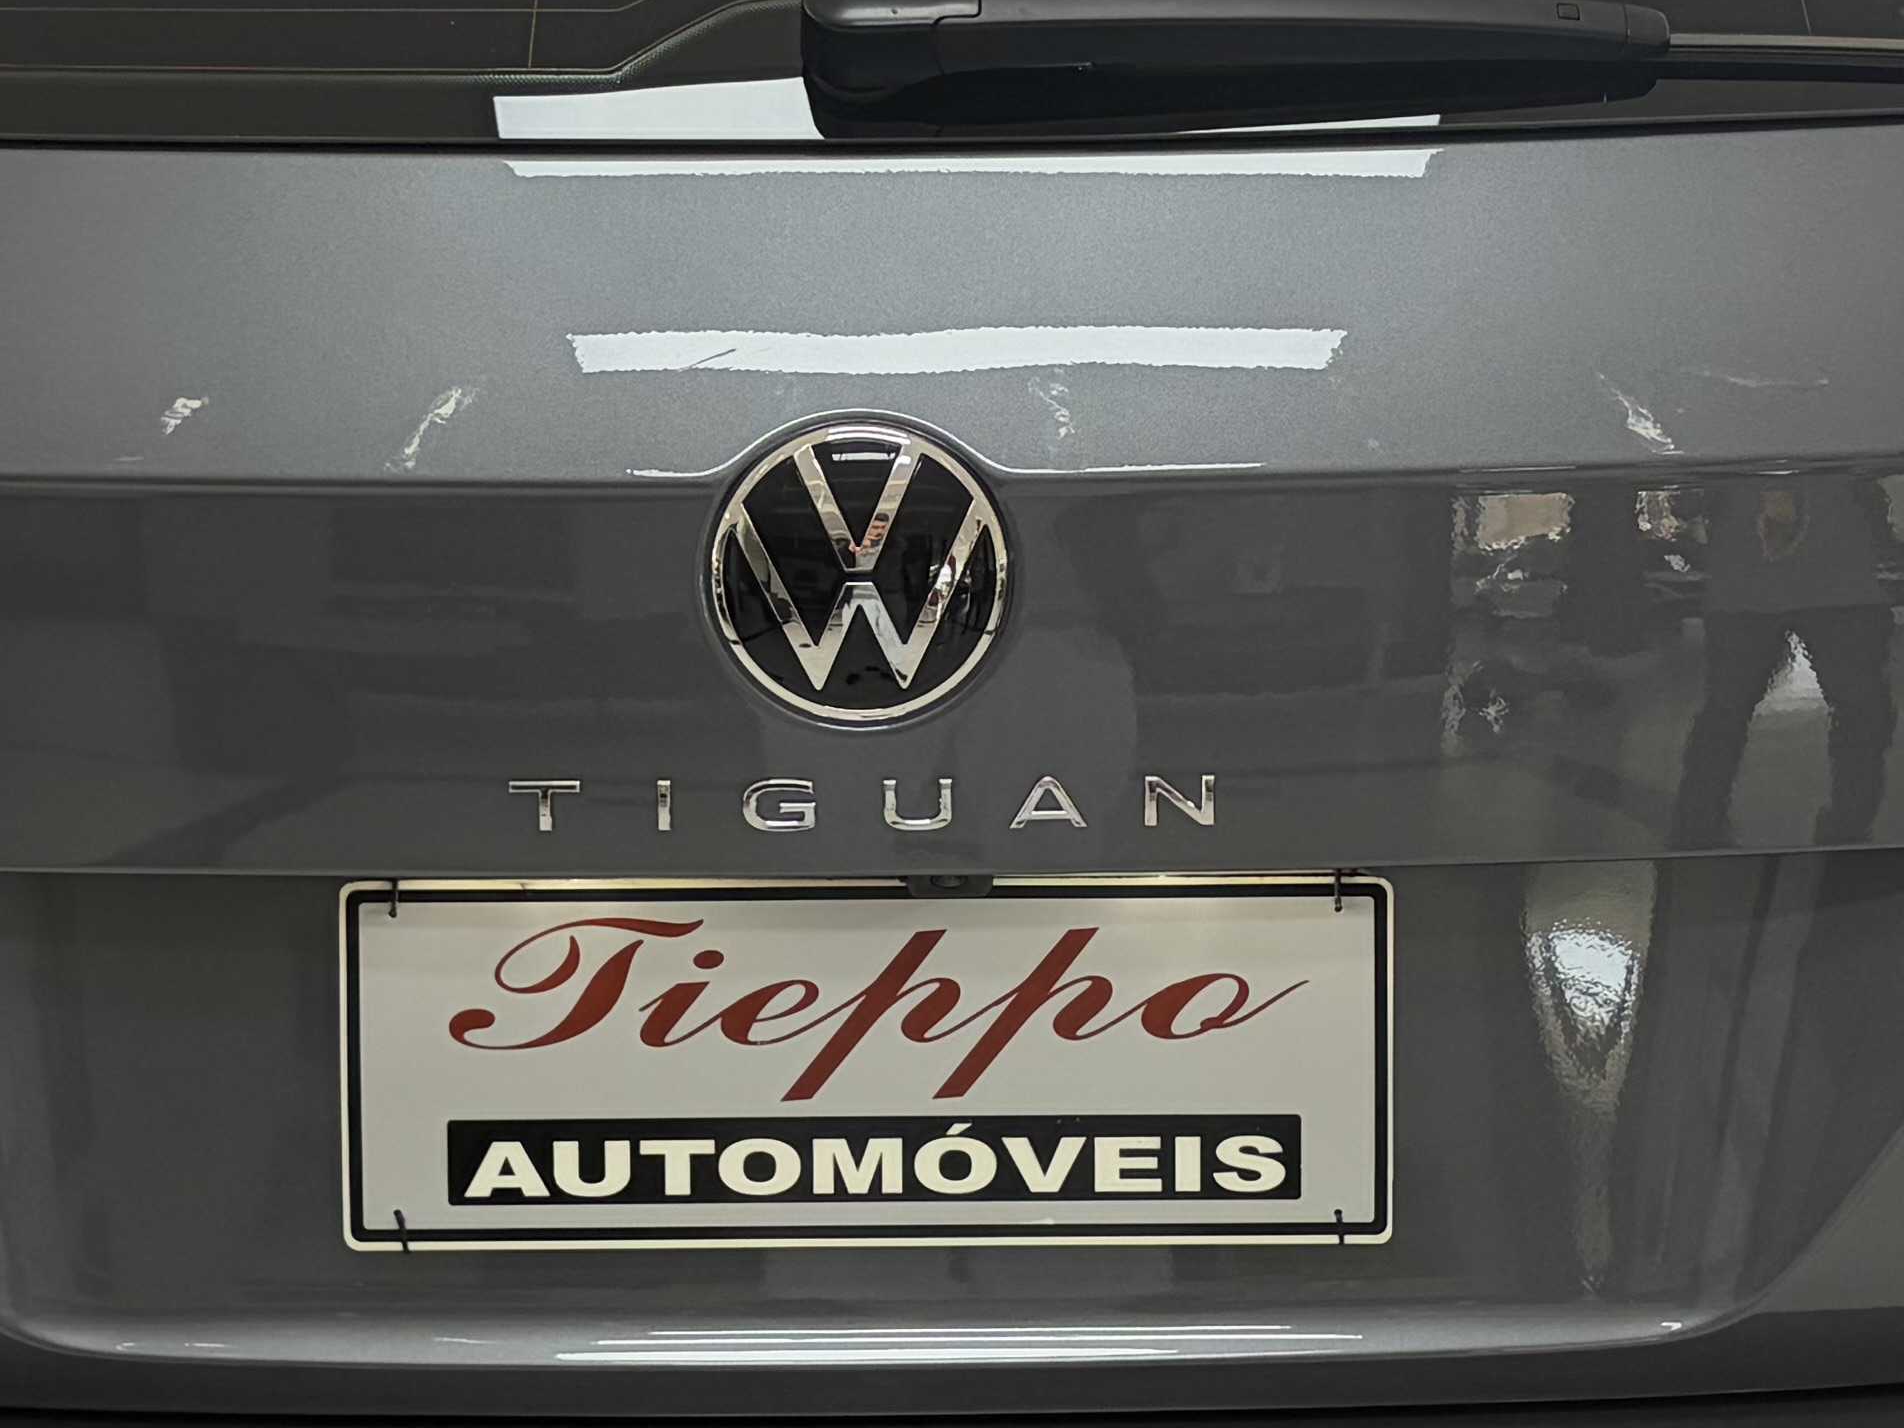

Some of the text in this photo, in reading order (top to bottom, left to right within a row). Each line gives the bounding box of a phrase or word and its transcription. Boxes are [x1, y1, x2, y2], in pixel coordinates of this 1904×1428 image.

[508, 774, 1217, 833] TIGUAN
[449, 917, 1309, 1101] Tieppo
[464, 1122, 1287, 1199] AUTOMÓVEIS
